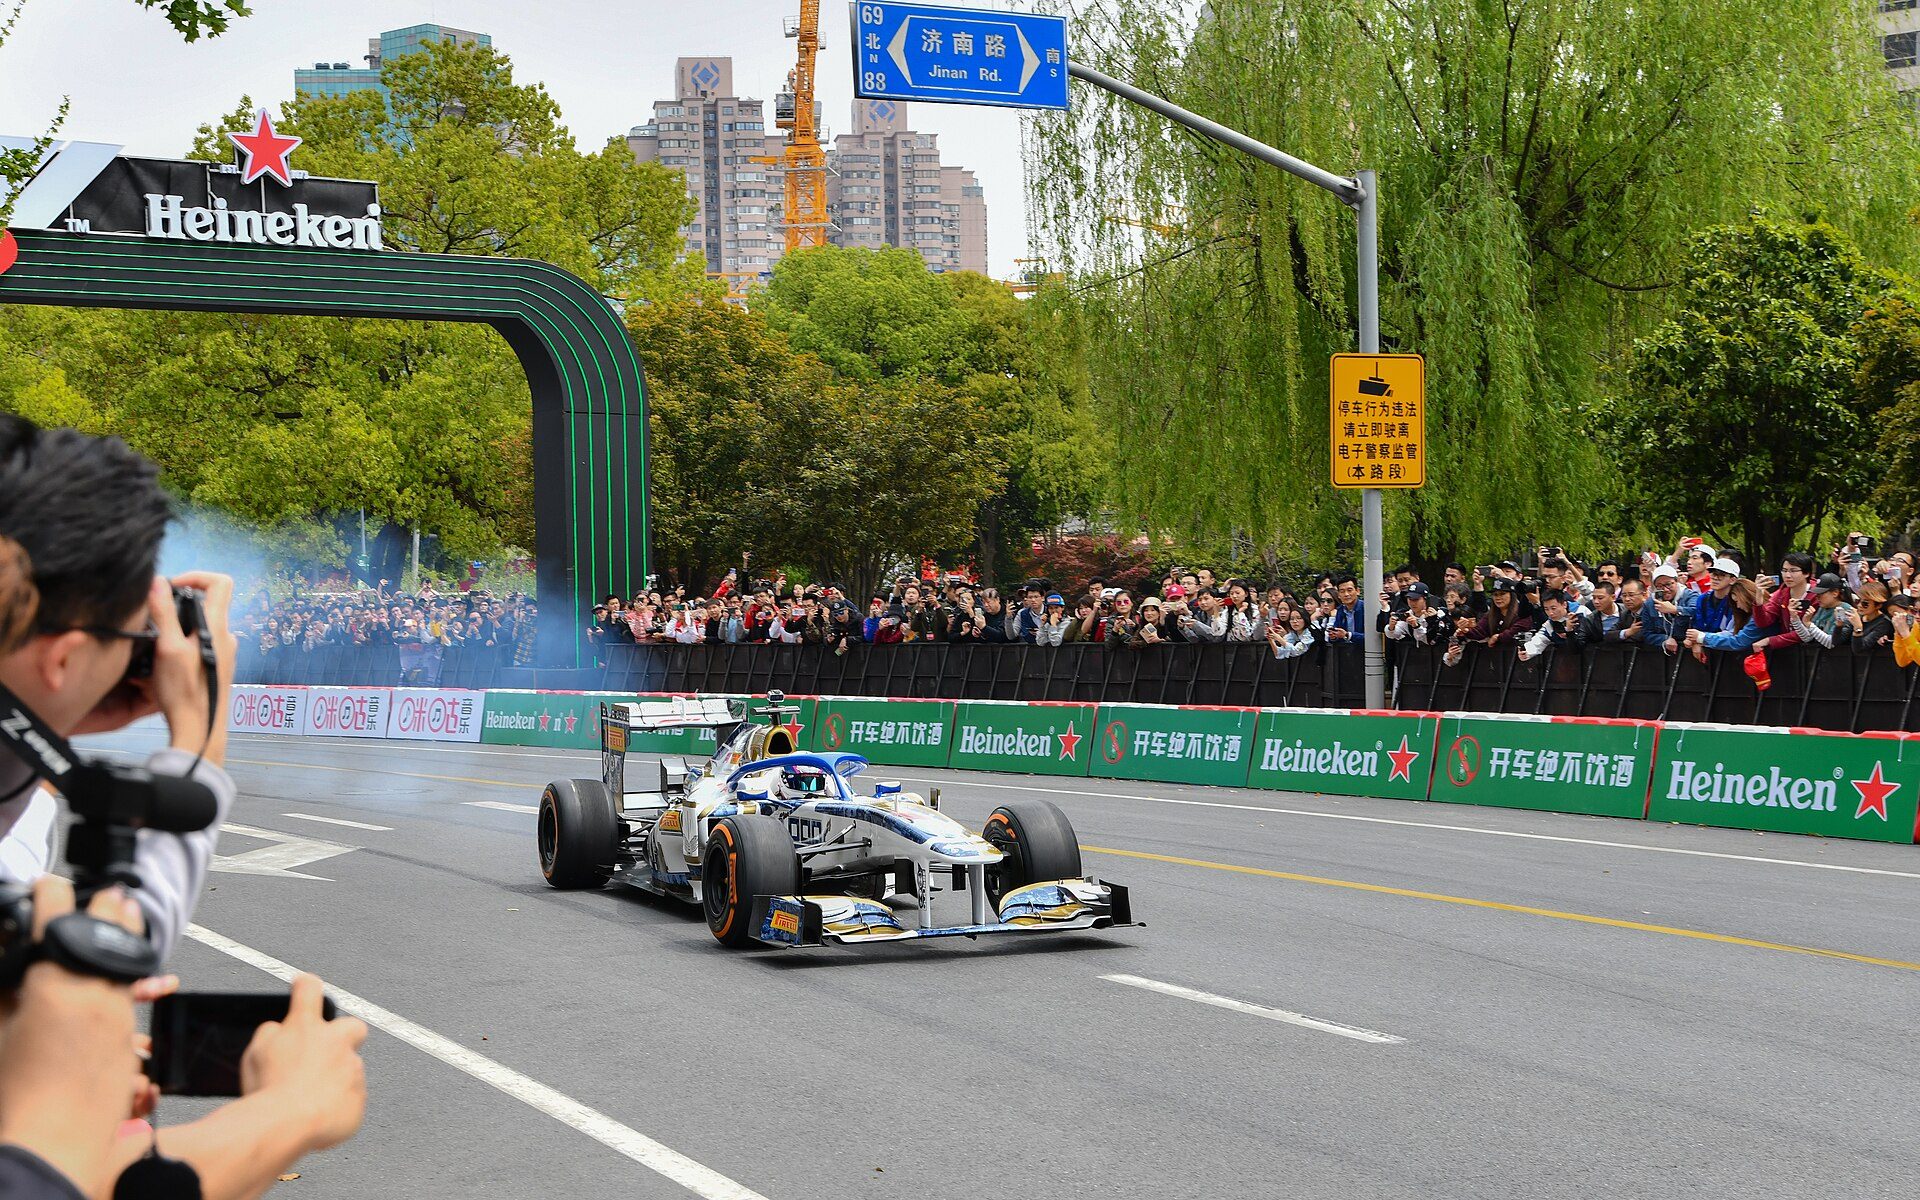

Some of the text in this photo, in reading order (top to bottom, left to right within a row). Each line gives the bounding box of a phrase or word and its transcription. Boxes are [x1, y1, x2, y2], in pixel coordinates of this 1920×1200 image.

[861, 5, 884, 25] 69
[865, 33, 881, 50] 北
[921, 28, 1006, 59] 济南路
[869, 54, 878, 64] N
[1046, 48, 1060, 65] 南
[864, 72, 886, 91] 88
[929, 65, 1003, 82] Jinan Rd.
[1050, 68, 1057, 78] S
[65, 219, 91, 233] TM
[144, 193, 384, 250] Heineken
[1338, 401, 1417, 417] 停车行为违法
[1343, 422, 1409, 438] 请立即驶离
[1338, 443, 1417, 459] 电子警察监管
[1347, 463, 1406, 480] (本路段)
[850, 721, 943, 746] 开车绝不饮酒
[1134, 730, 1242, 762] 开车绝不饮酒
[1490, 747, 1636, 788] 开车绝不饮酒
